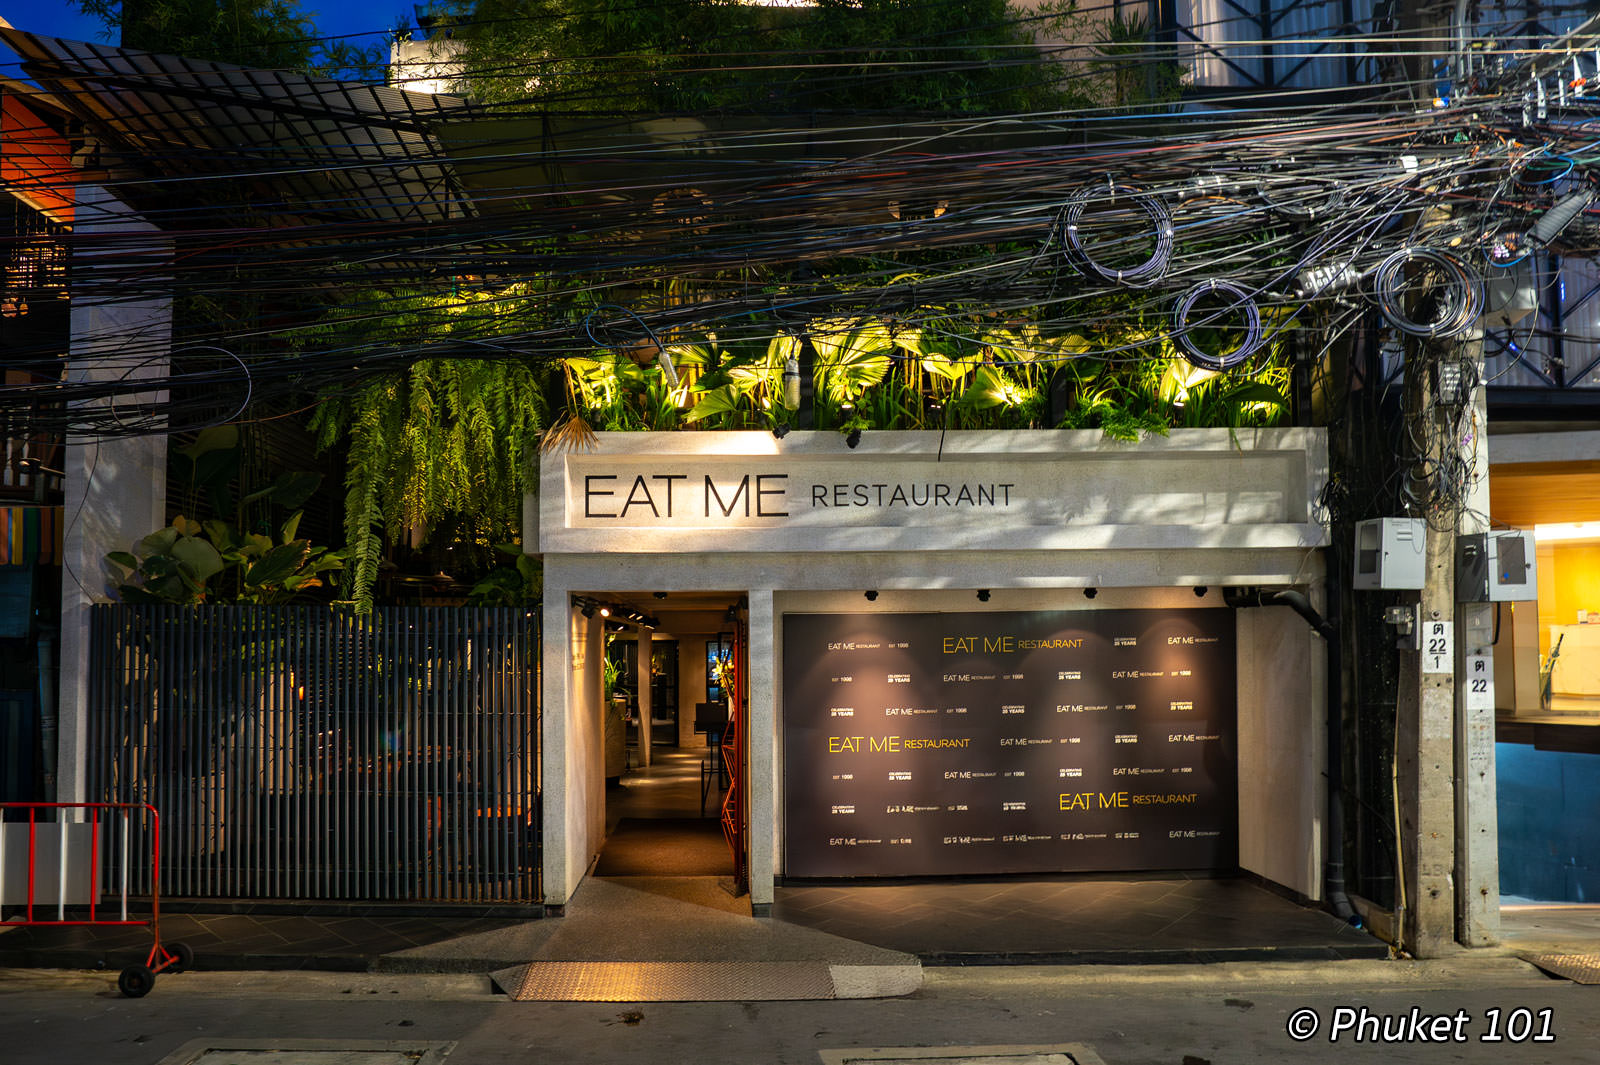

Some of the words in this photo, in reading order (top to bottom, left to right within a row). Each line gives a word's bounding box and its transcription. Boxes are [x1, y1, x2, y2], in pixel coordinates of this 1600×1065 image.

[584, 475, 688, 518] EAT
[704, 474, 788, 518] ME
[812, 484, 1015, 508] RESTAURANT
[944, 637, 978, 653] EAT
[984, 637, 1015, 653] ME
[1018, 639, 1082, 649] RESTAURANT
[1429, 638, 1446, 652] 22
[1434, 656, 1439, 669] 1
[1472, 680, 1487, 692] 22
[829, 737, 864, 753] EAT
[870, 736, 900, 752] ME
[904, 738, 970, 748] RESTAURANT
[1059, 792, 1094, 810] EAT
[1099, 792, 1128, 808] ME
[1133, 793, 1197, 804] RESTAURANT
